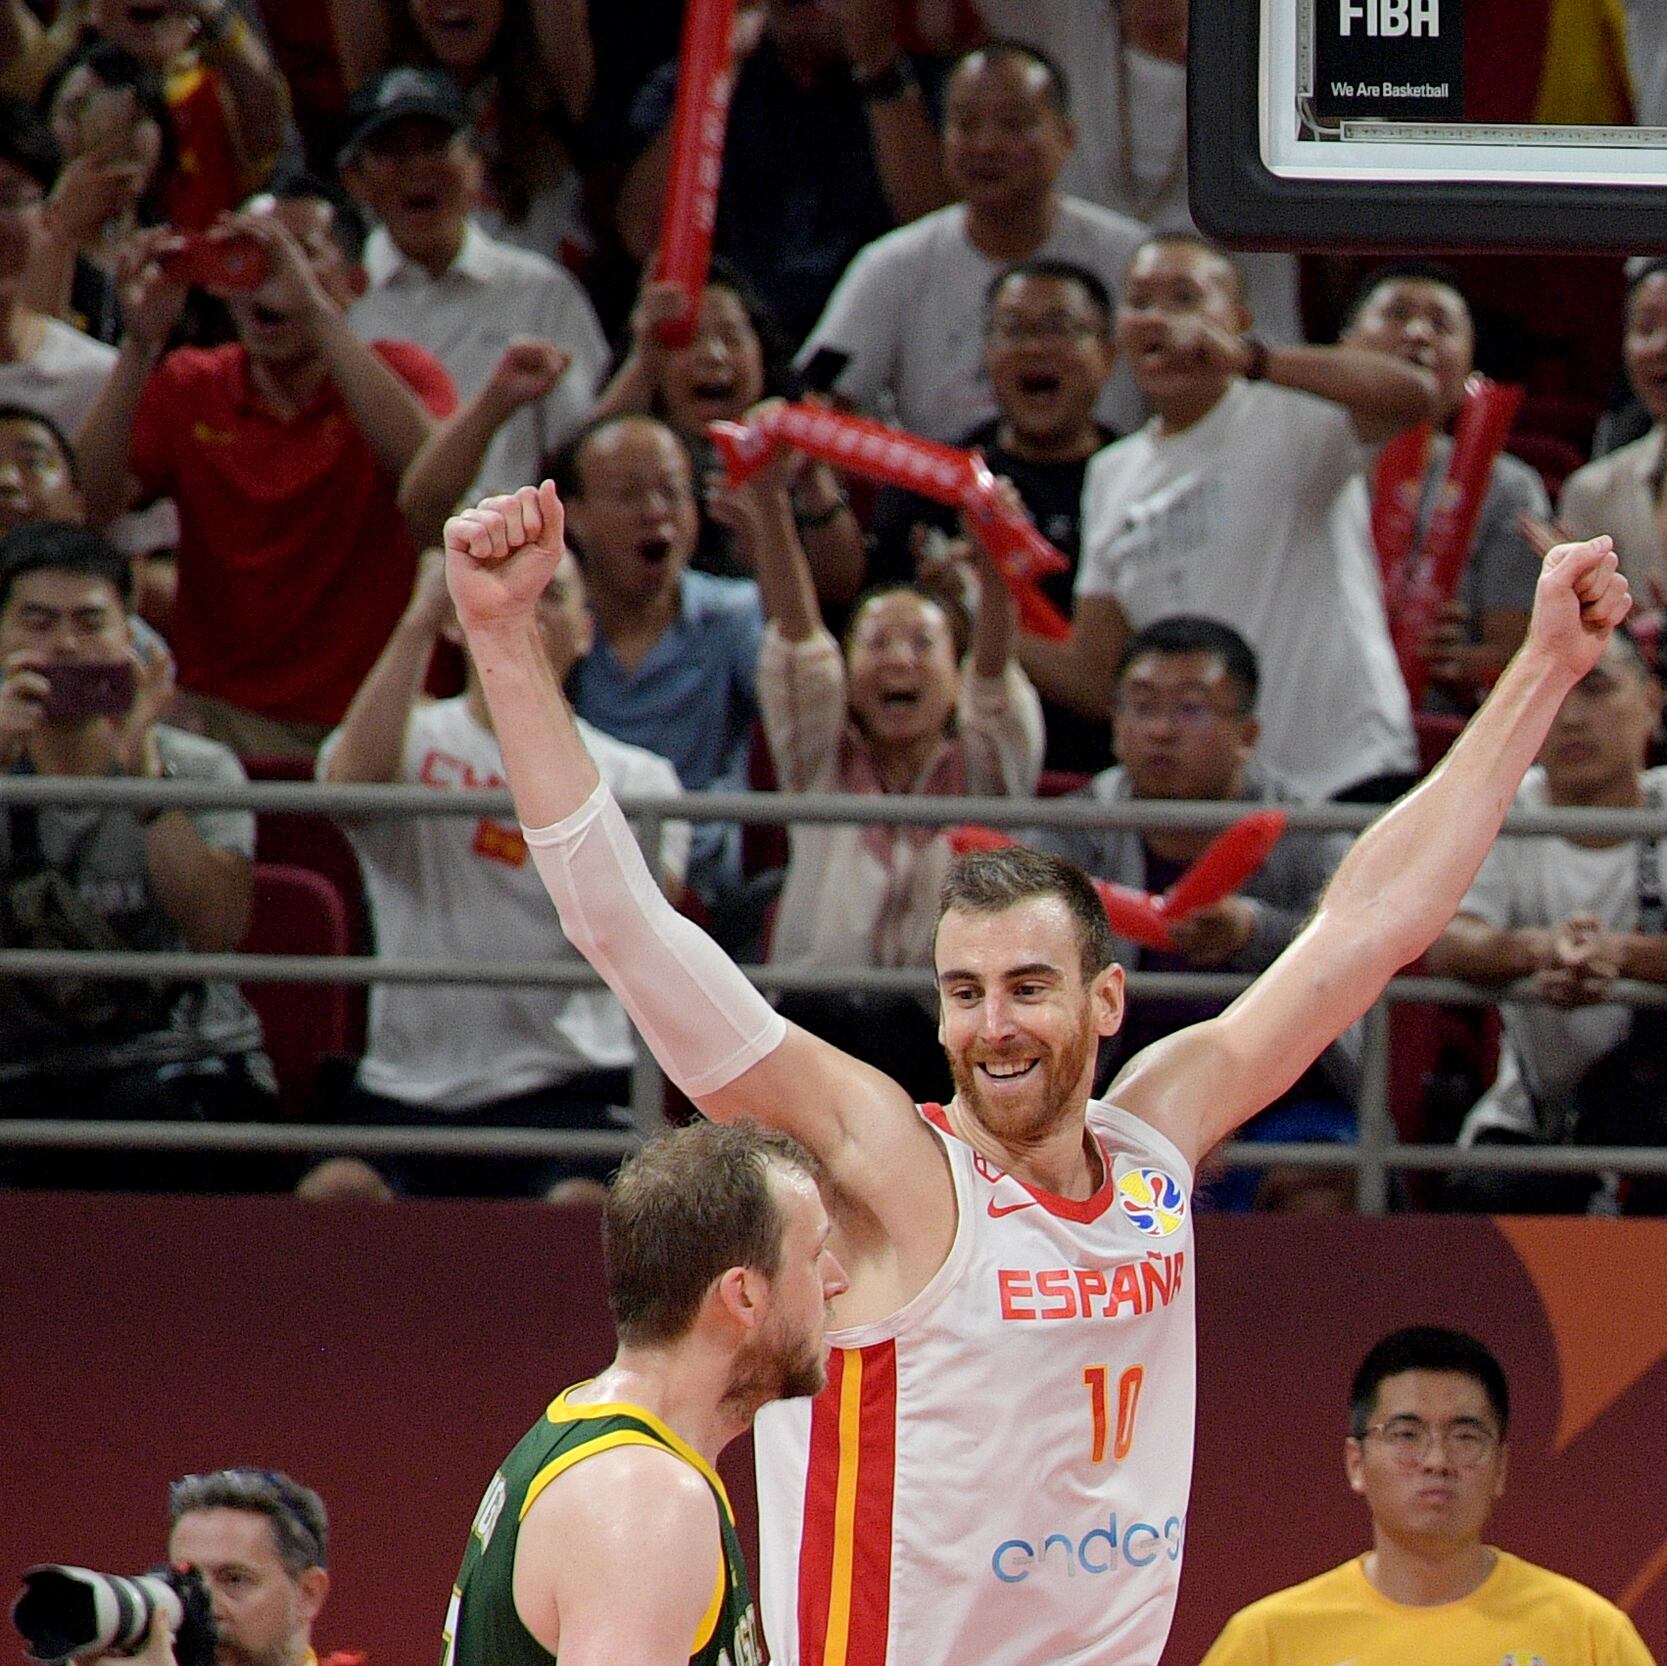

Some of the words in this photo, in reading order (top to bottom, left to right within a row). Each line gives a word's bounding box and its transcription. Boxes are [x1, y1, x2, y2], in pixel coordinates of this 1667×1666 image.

[1340, 0, 1440, 37] FIBA
[1331, 82, 1354, 97] We
[1356, 82, 1379, 97] Are
[1382, 82, 1449, 98] Basketball
[1083, 1363, 1145, 1464] 10
[992, 1512, 1182, 1583] endes
